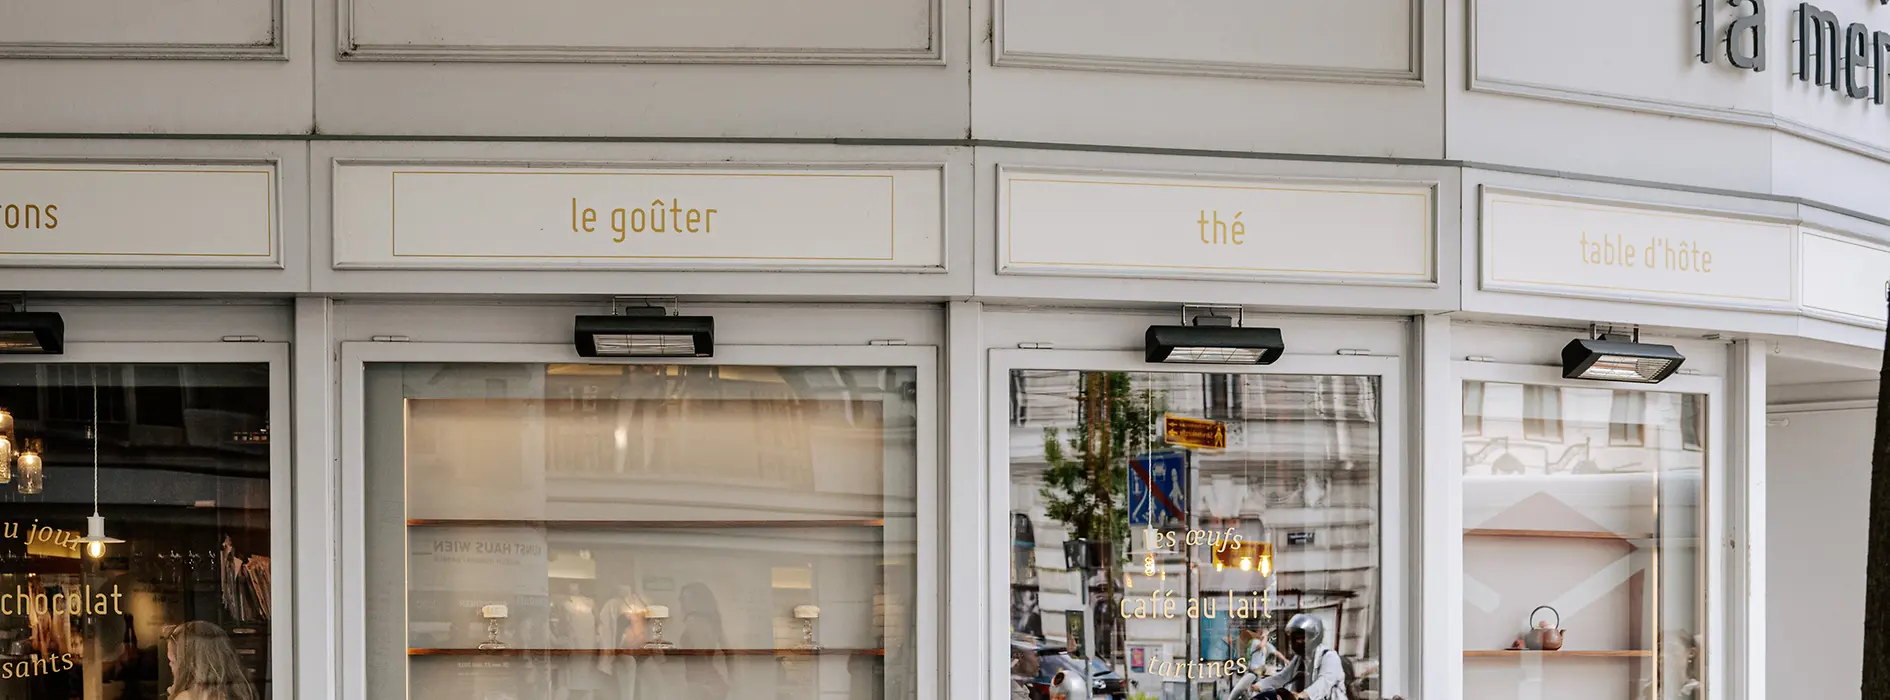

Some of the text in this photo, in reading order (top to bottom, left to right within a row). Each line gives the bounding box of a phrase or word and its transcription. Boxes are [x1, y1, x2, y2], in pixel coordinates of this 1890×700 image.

[0, 204, 58, 229] ons
[572, 197, 718, 243] le goûter
[1197, 209, 1245, 245] thé
[1580, 231, 1713, 273] table d'hôte
[4, 518, 87, 551] u jour
[1186, 527, 1243, 553] œufs
[1, 584, 123, 616] chocolat
[1120, 589, 1273, 619] café au lait
[2, 652, 74, 680] sants
[1148, 655, 1248, 680] tartines
